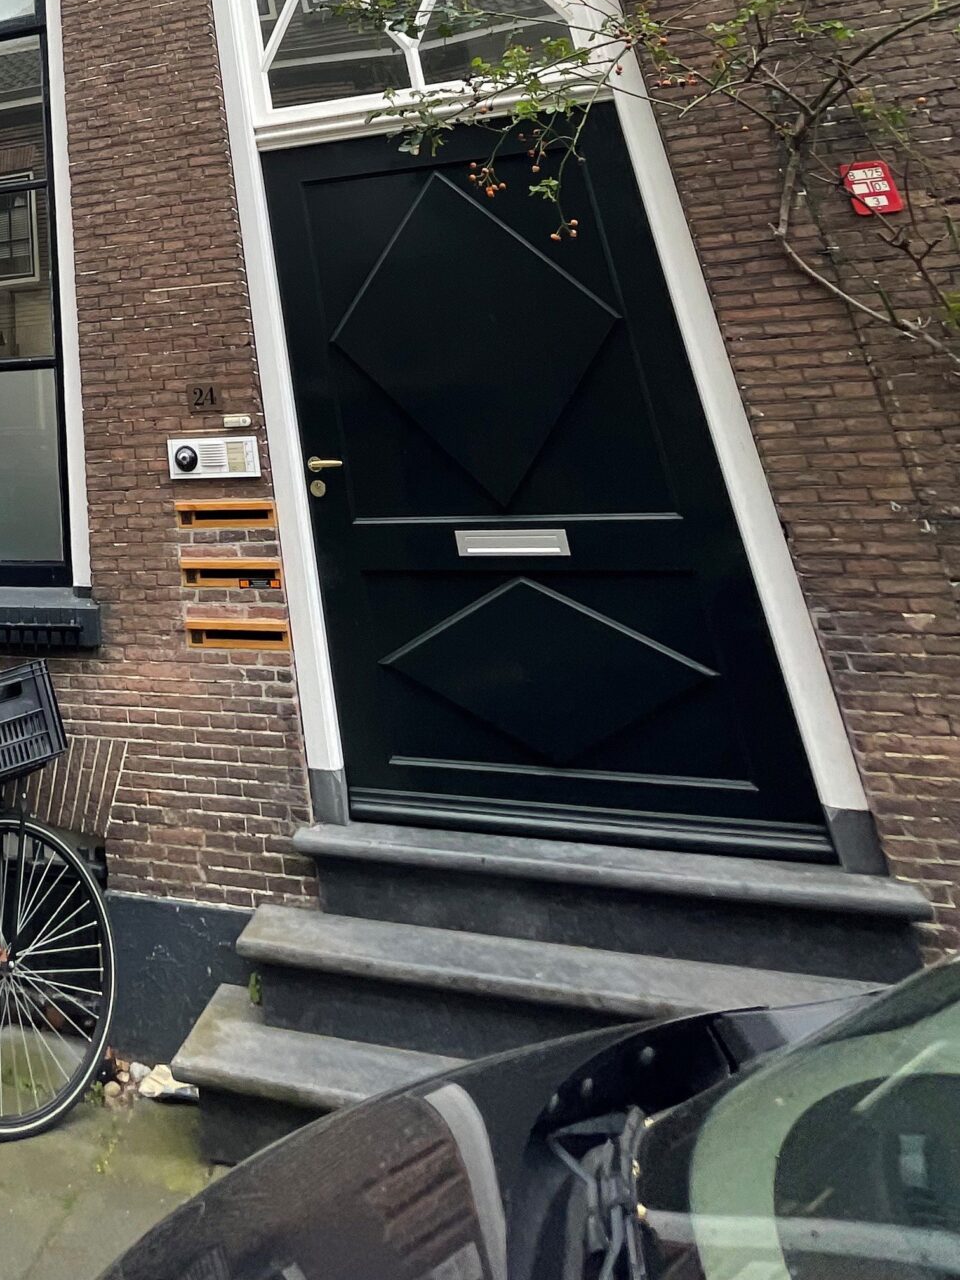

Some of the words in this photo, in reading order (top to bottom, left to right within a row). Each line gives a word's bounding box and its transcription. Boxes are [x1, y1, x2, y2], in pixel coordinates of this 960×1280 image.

[862, 168, 883, 178] 175
[872, 197, 881, 206] 3
[193, 386, 217, 406] 24
